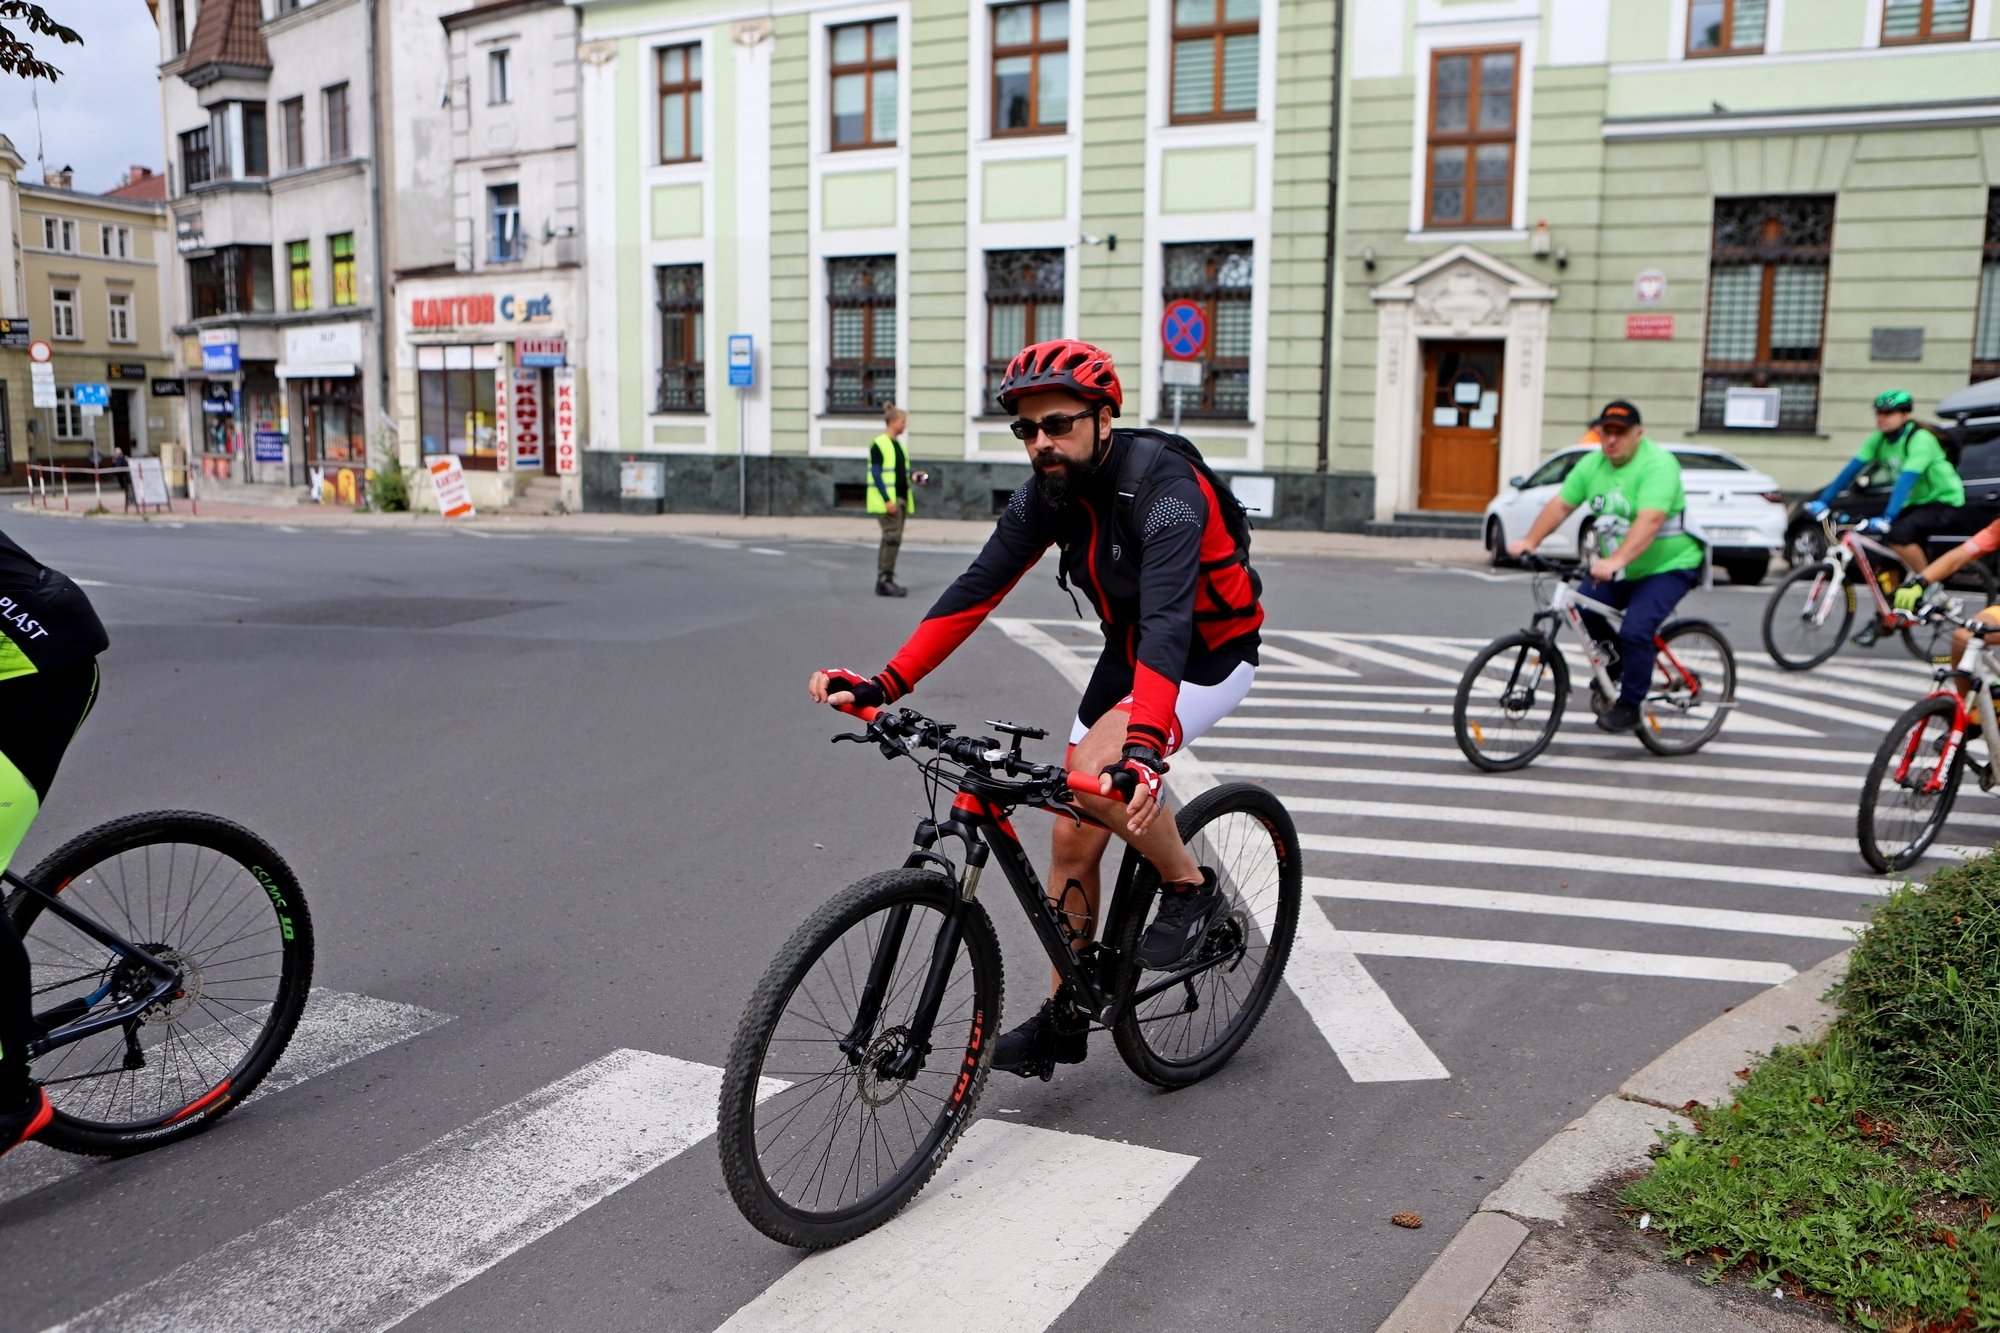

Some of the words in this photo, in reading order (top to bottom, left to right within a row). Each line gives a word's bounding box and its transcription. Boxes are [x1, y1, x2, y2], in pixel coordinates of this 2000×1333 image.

[411, 294, 495, 327] KANTOR
[516, 384, 539, 455] KANTOR
[559, 386, 573, 470] KANTOR
[0, 596, 49, 639] PLAST
[931, 1103, 967, 1162] RAPID
